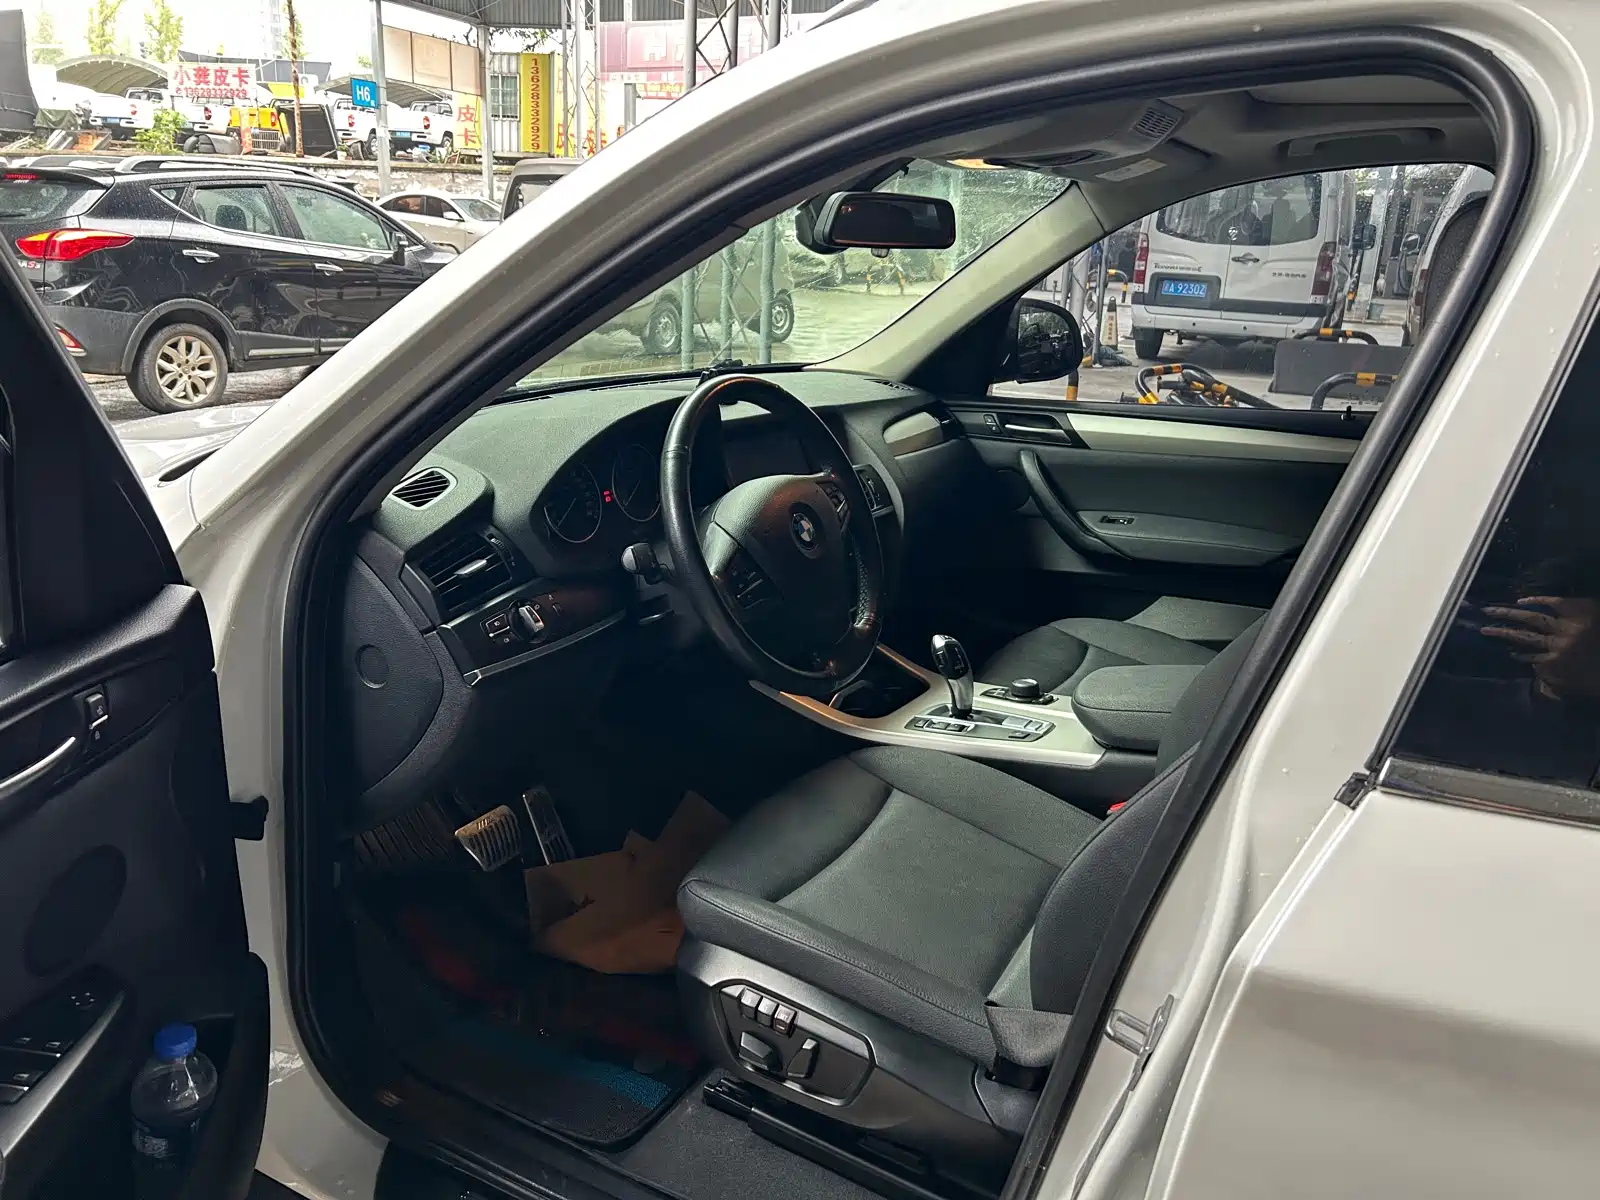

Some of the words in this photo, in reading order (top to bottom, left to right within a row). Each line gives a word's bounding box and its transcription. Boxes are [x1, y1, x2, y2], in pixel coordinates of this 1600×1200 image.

[183, 87, 248, 98] 13628332929
[356, 84, 371, 103] H6
[530, 57, 541, 151] 13628332929
[456, 104, 477, 146] 皮卡
[1163, 281, 1207, 295] A9230Z
